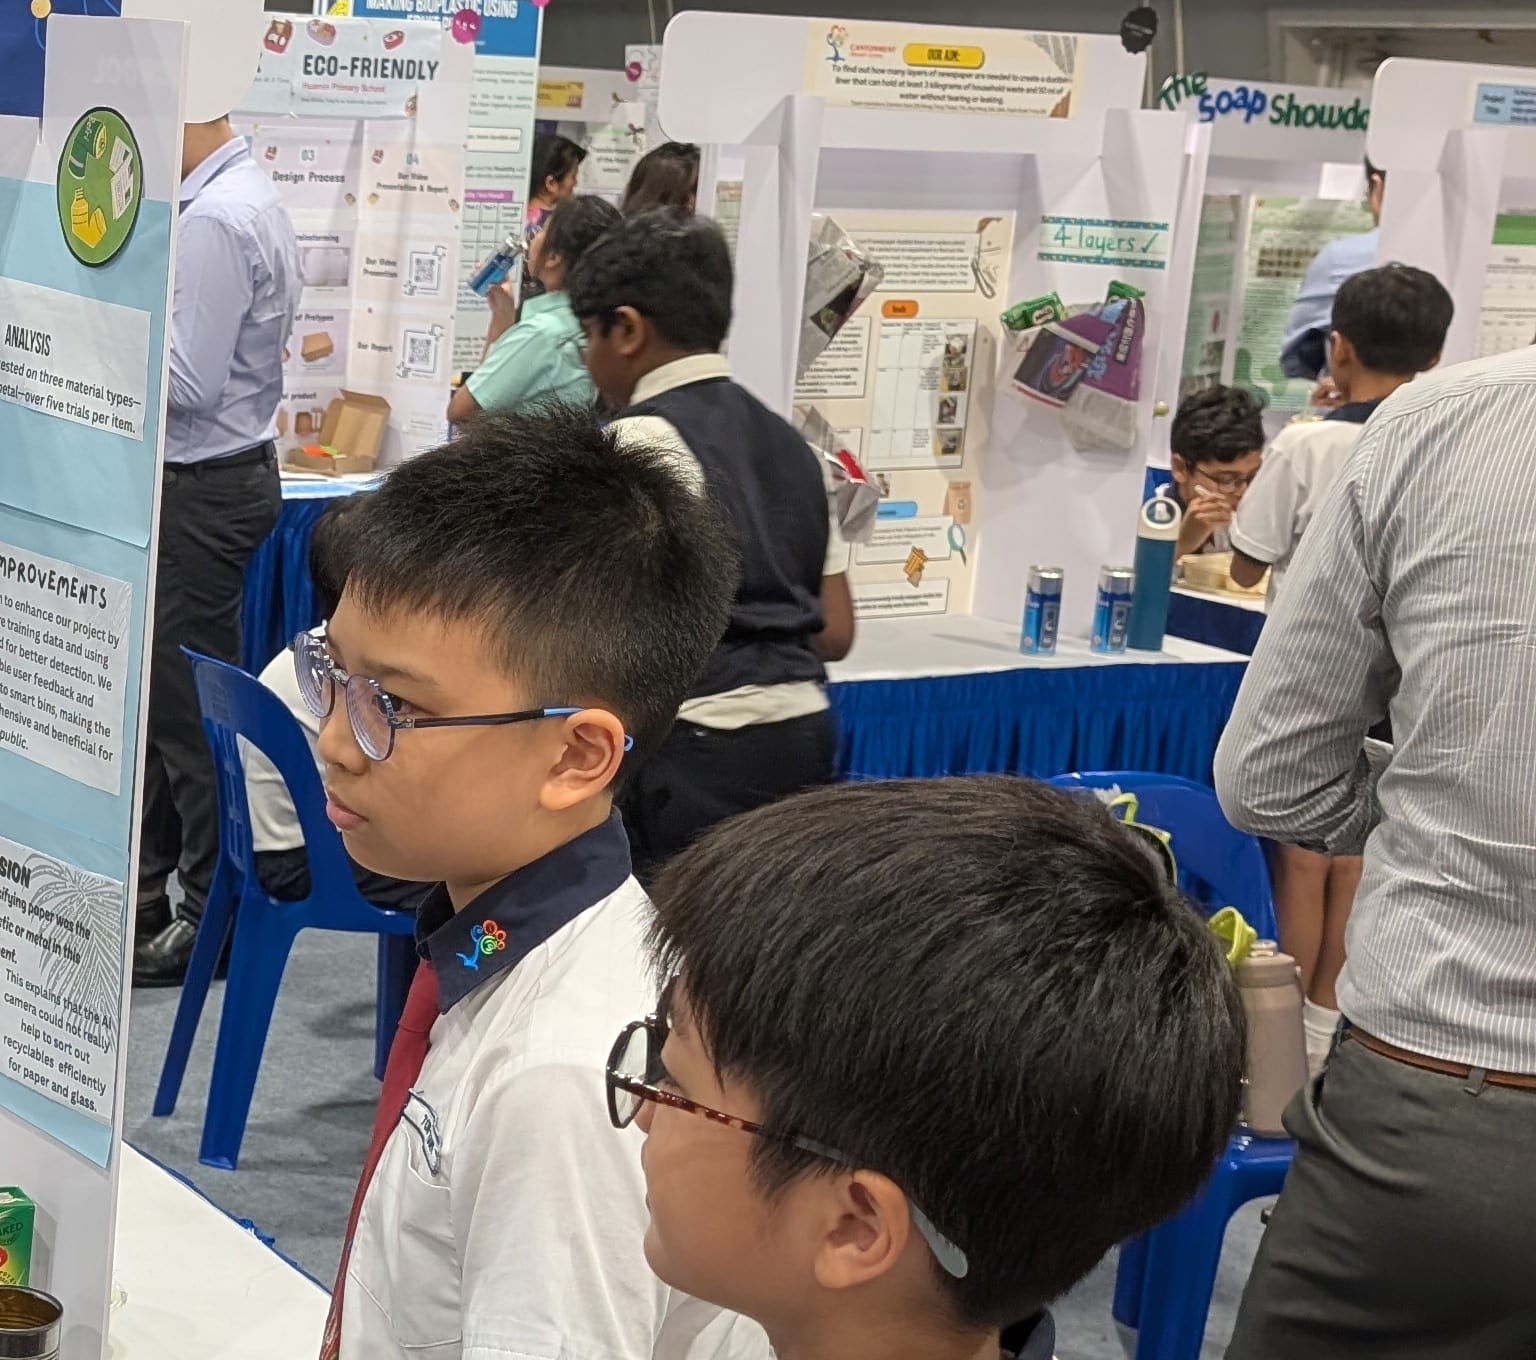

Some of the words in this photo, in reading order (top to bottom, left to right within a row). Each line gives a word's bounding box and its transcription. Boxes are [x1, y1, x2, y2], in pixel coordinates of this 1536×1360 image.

[303, 54, 439, 80] ECO-FRIENDLY
[1159, 71, 1208, 111] The
[1198, 84, 1268, 124] Soap
[272, 172, 304, 184] Design
[309, 173, 345, 184] Process
[1054, 224, 1072, 247] 4
[1079, 224, 1136, 259] layers
[4, 323, 51, 357] ANALYSIS
[26, 365, 38, 378] on
[39, 365, 64, 388] three
[65, 375, 104, 400] material
